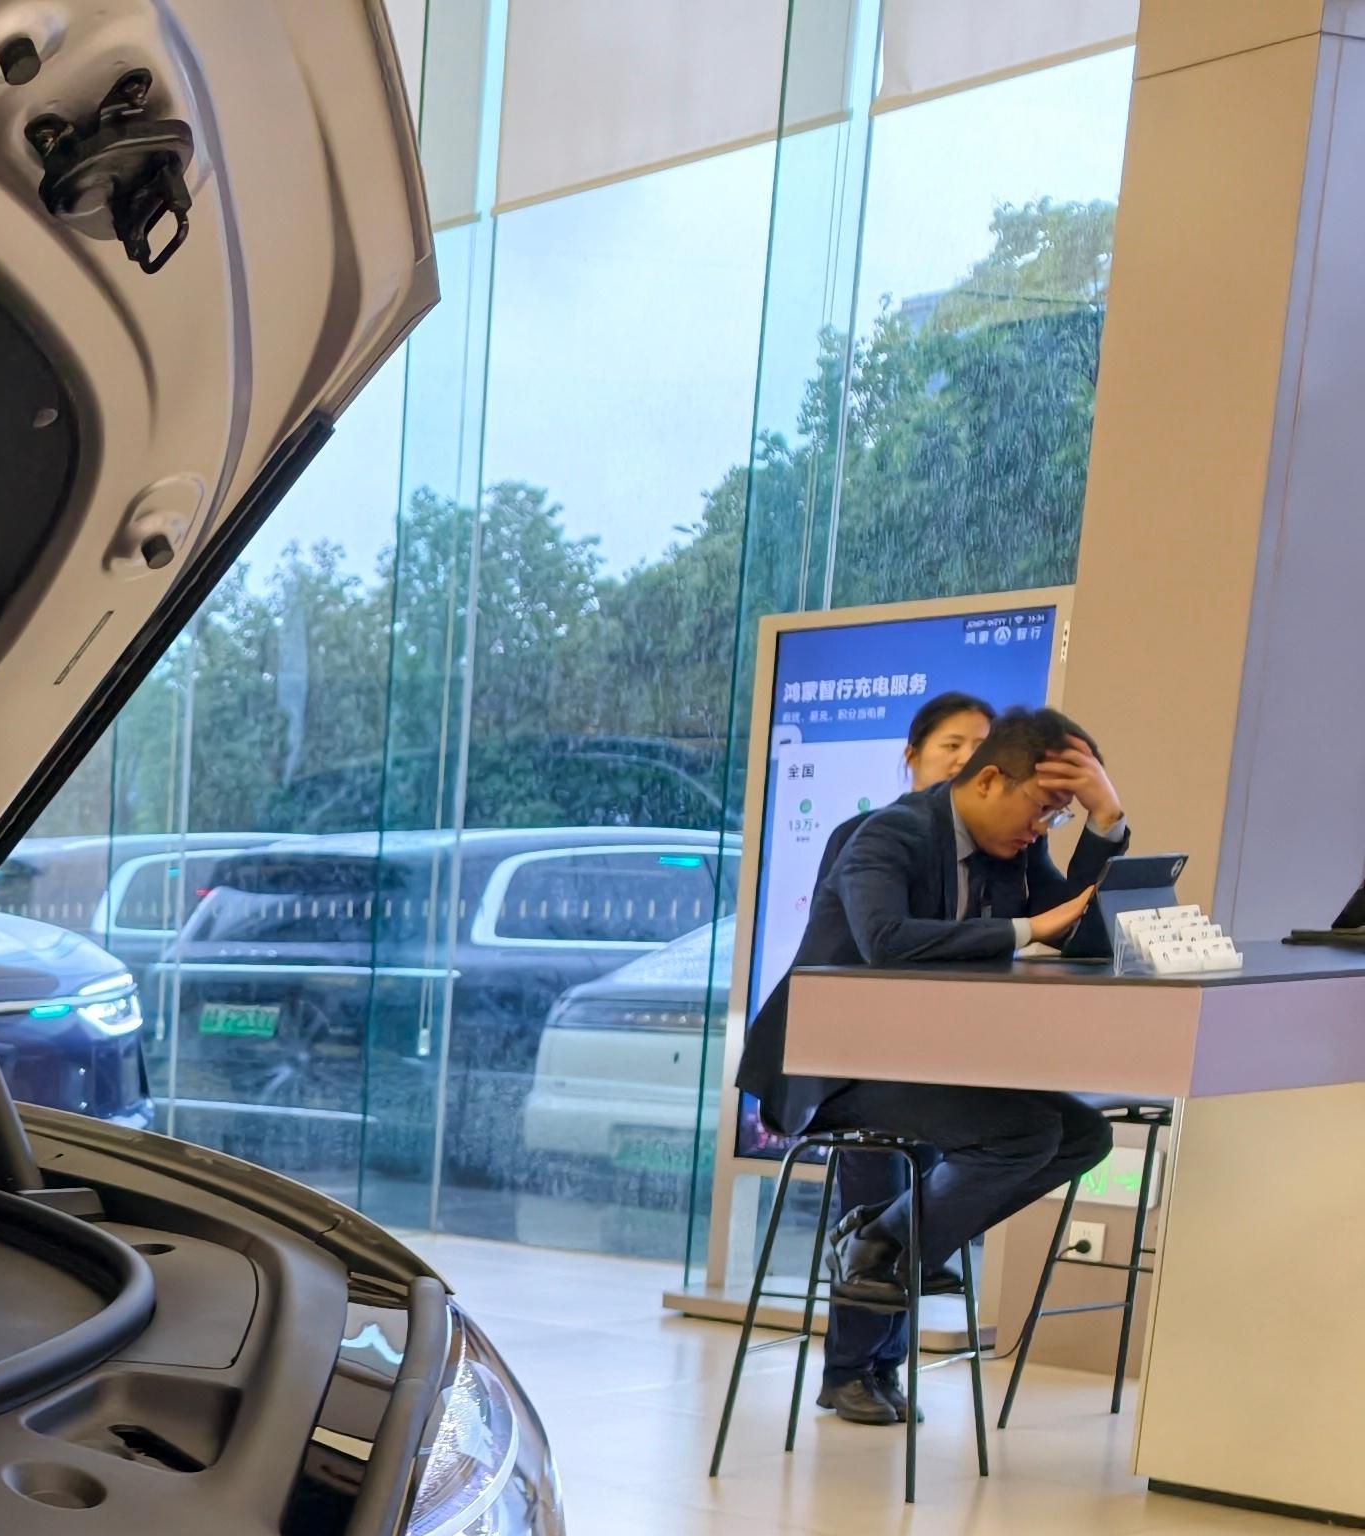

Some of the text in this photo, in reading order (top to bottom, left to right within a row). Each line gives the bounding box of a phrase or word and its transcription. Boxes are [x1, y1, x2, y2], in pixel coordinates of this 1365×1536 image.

[782, 672, 928, 703] 鸿蒙智行充电服务
[787, 763, 815, 780] 全国
